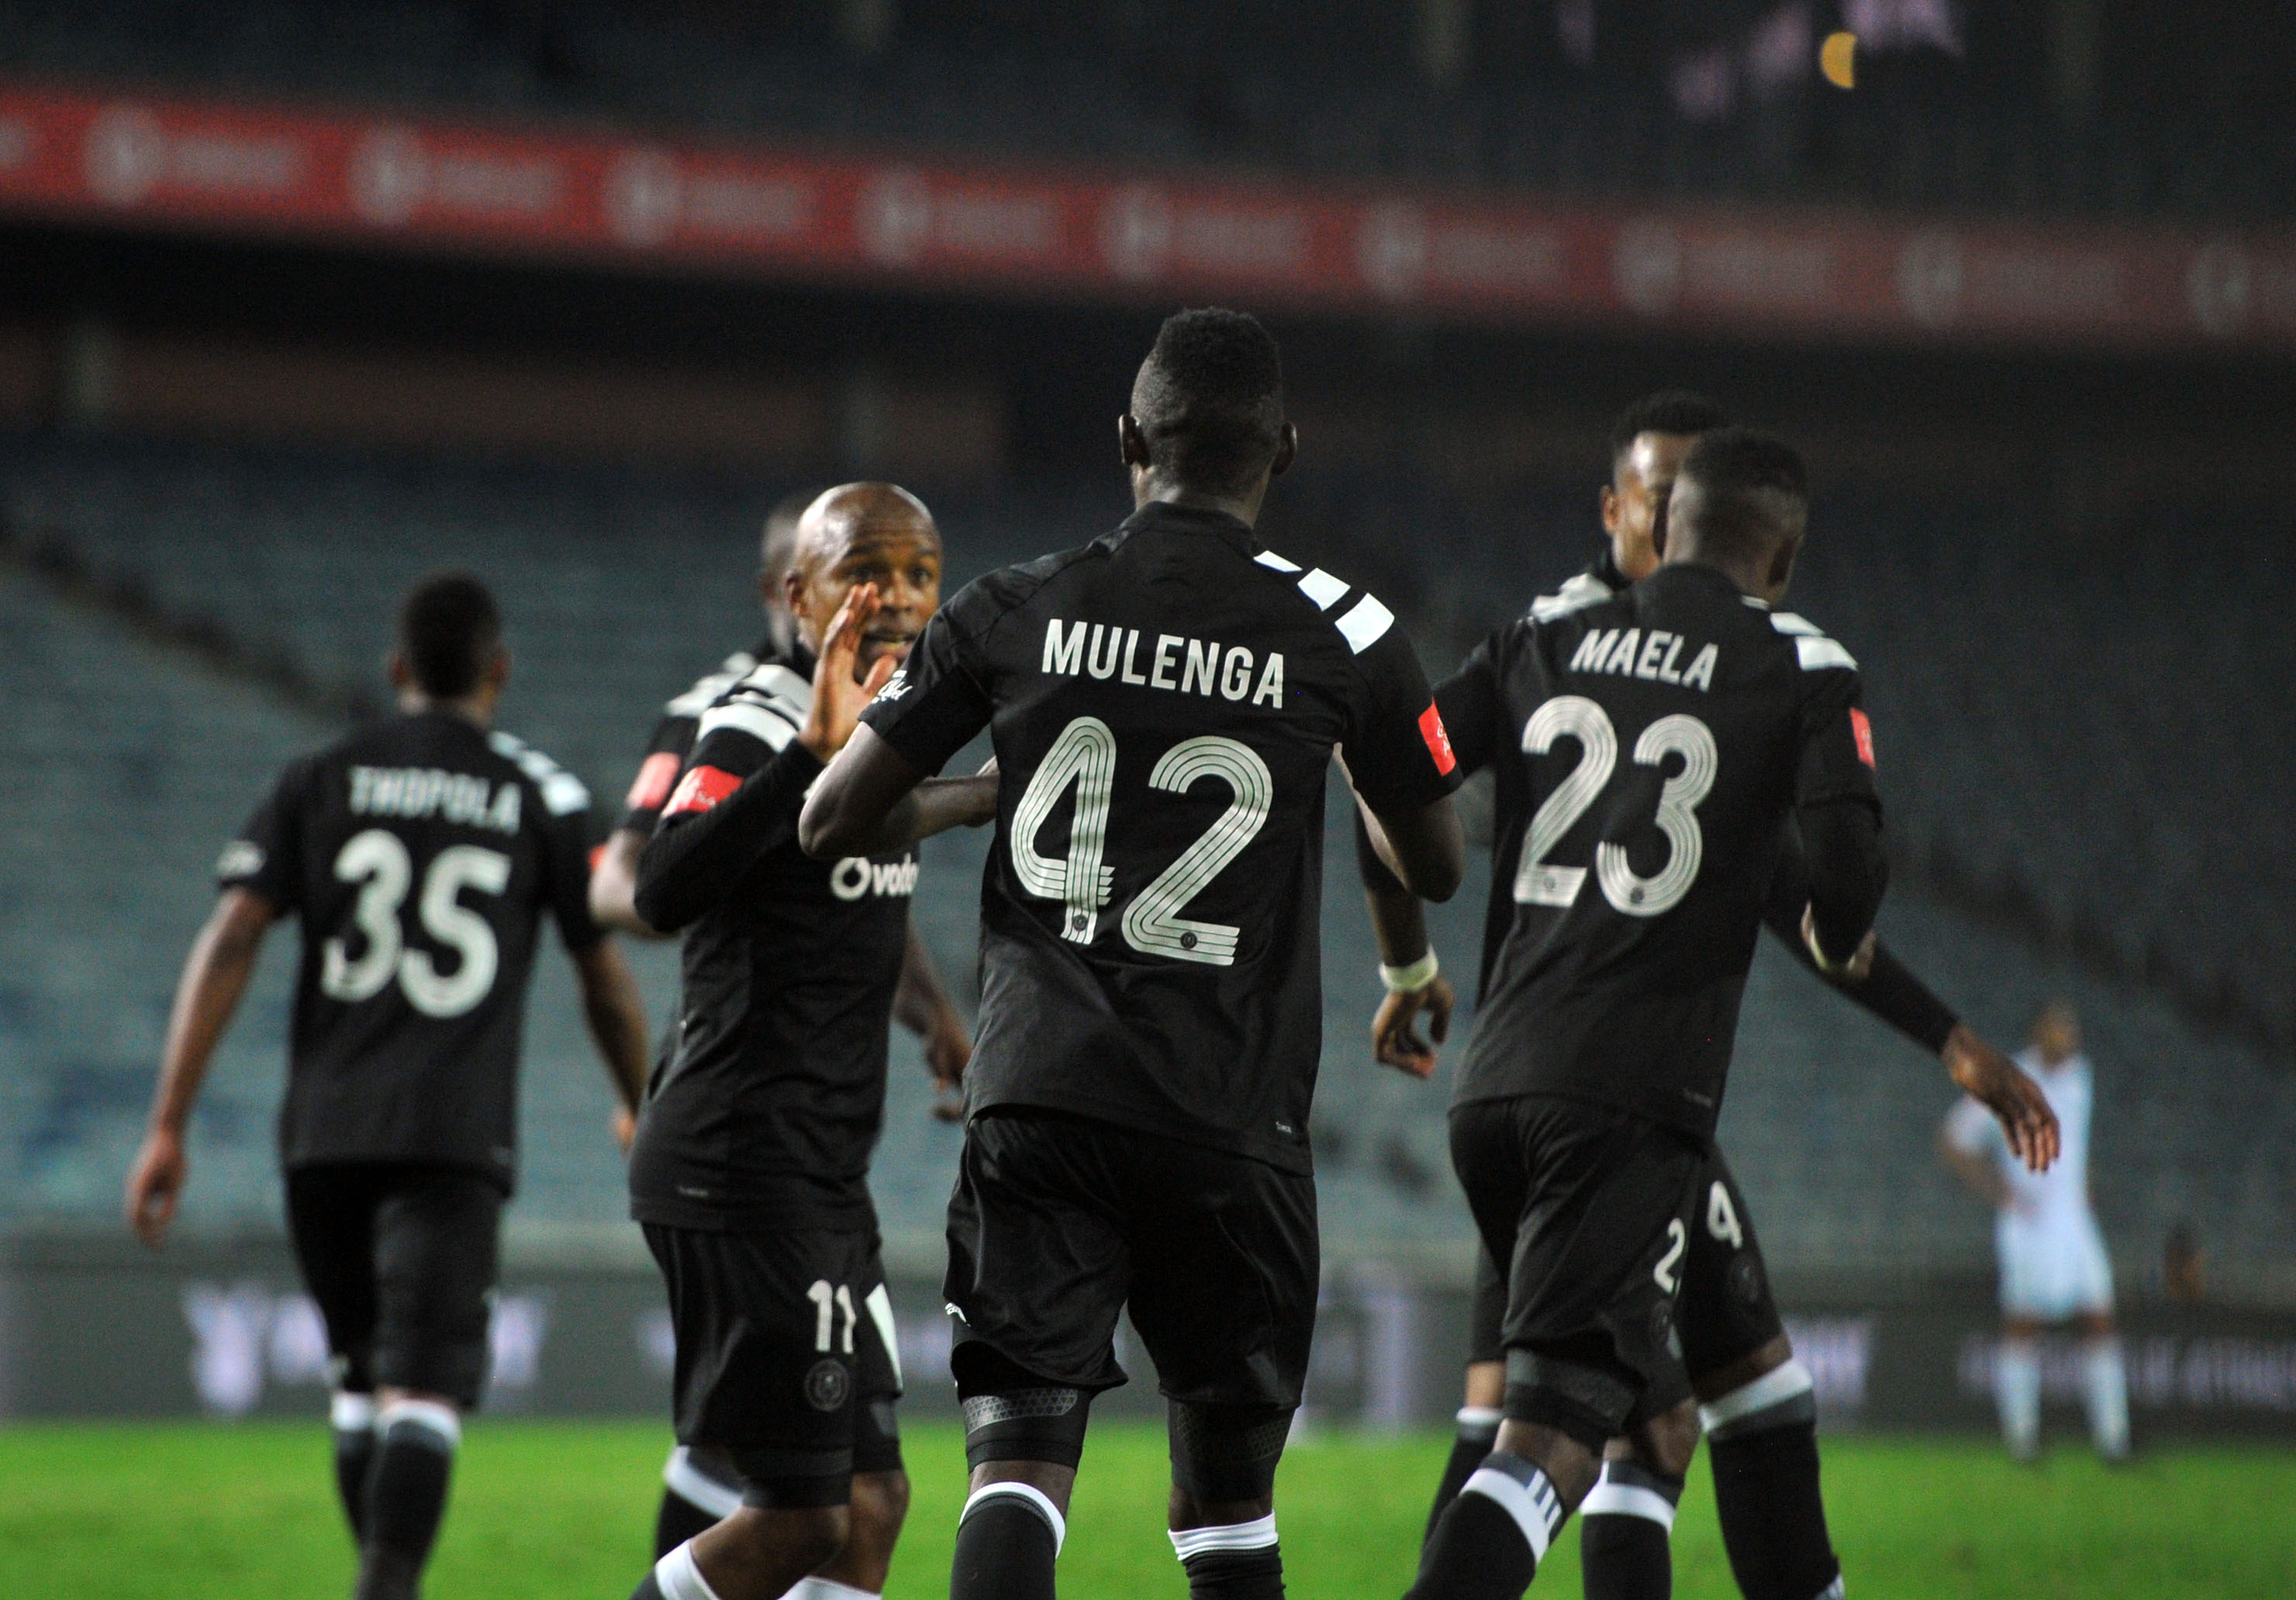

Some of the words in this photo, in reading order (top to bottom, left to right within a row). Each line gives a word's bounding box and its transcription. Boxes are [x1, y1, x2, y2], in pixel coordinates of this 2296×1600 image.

[1041, 619, 1284, 709] MULENGA
[1569, 627, 1719, 692] MAELA
[1011, 716, 1273, 966] 42
[1514, 695, 1718, 918] 23
[319, 828, 513, 1019] 35
[1707, 1180, 1743, 1250] 4
[806, 1279, 856, 1354] 11
